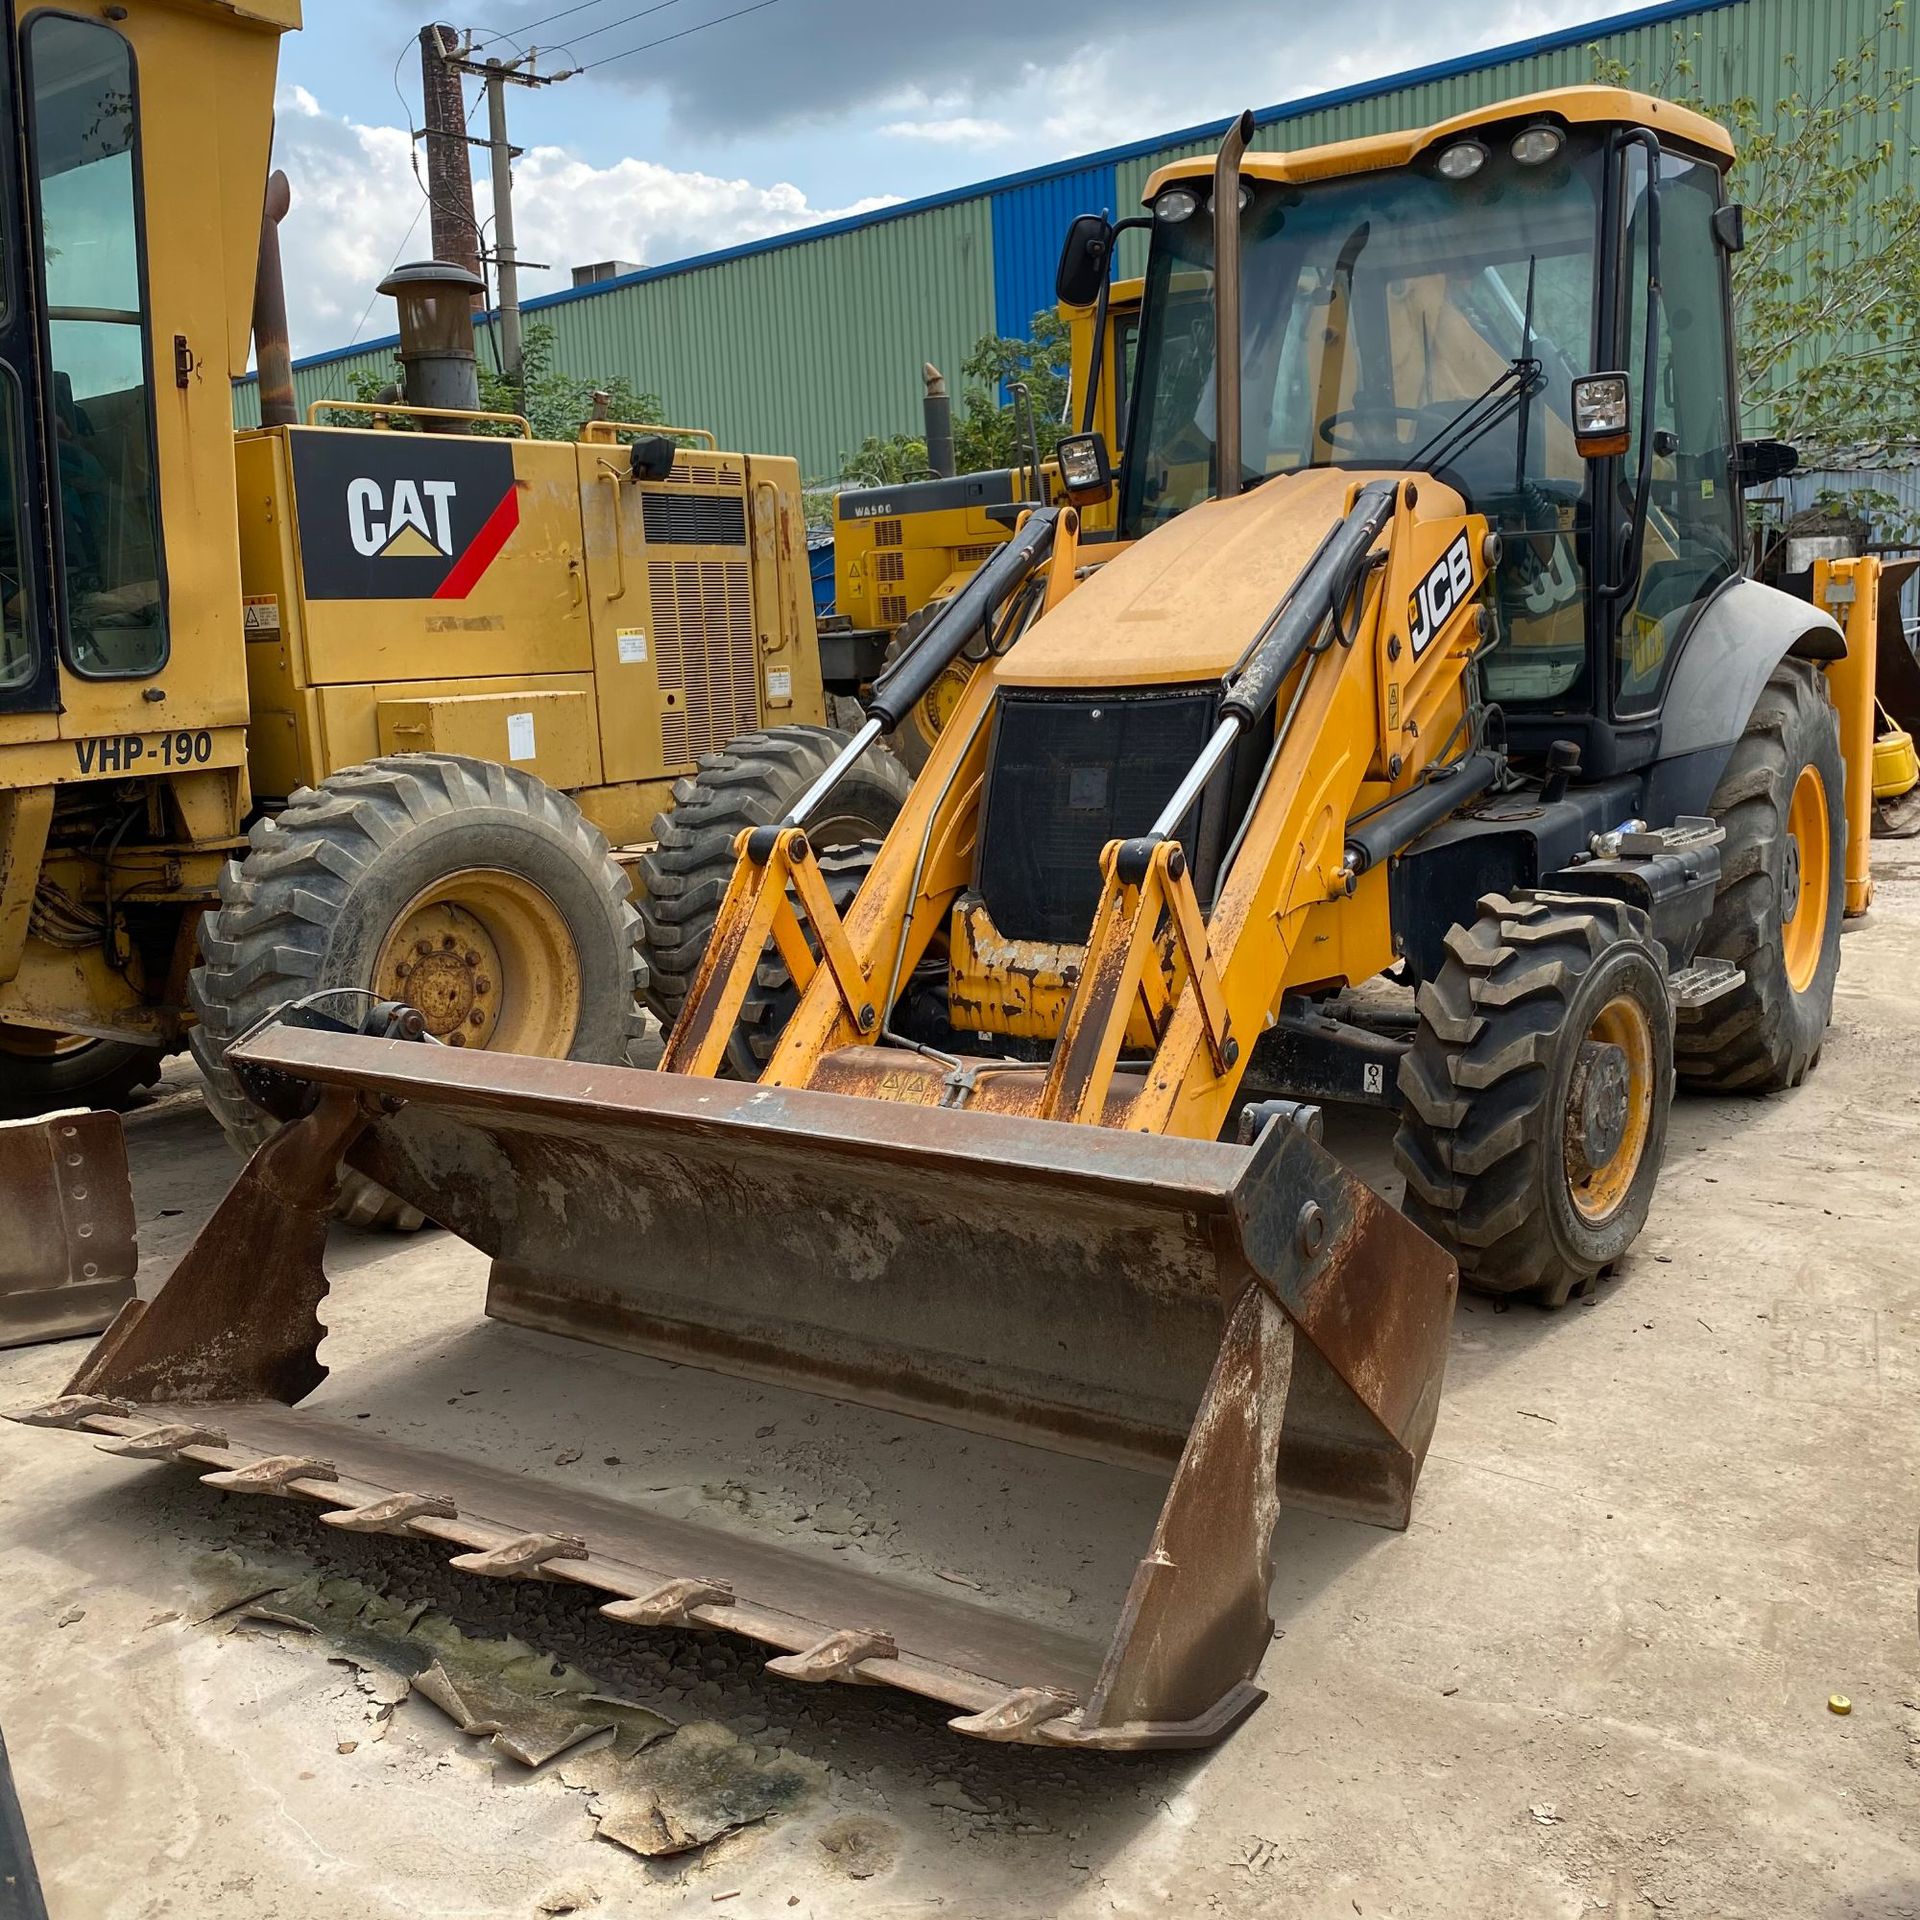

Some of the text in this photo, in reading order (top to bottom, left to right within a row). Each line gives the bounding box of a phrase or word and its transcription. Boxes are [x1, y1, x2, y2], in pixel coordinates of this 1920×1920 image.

[347, 477, 456, 557] CAT
[1411, 535, 1472, 652] JCB
[75, 731, 212, 774] VHP-190
